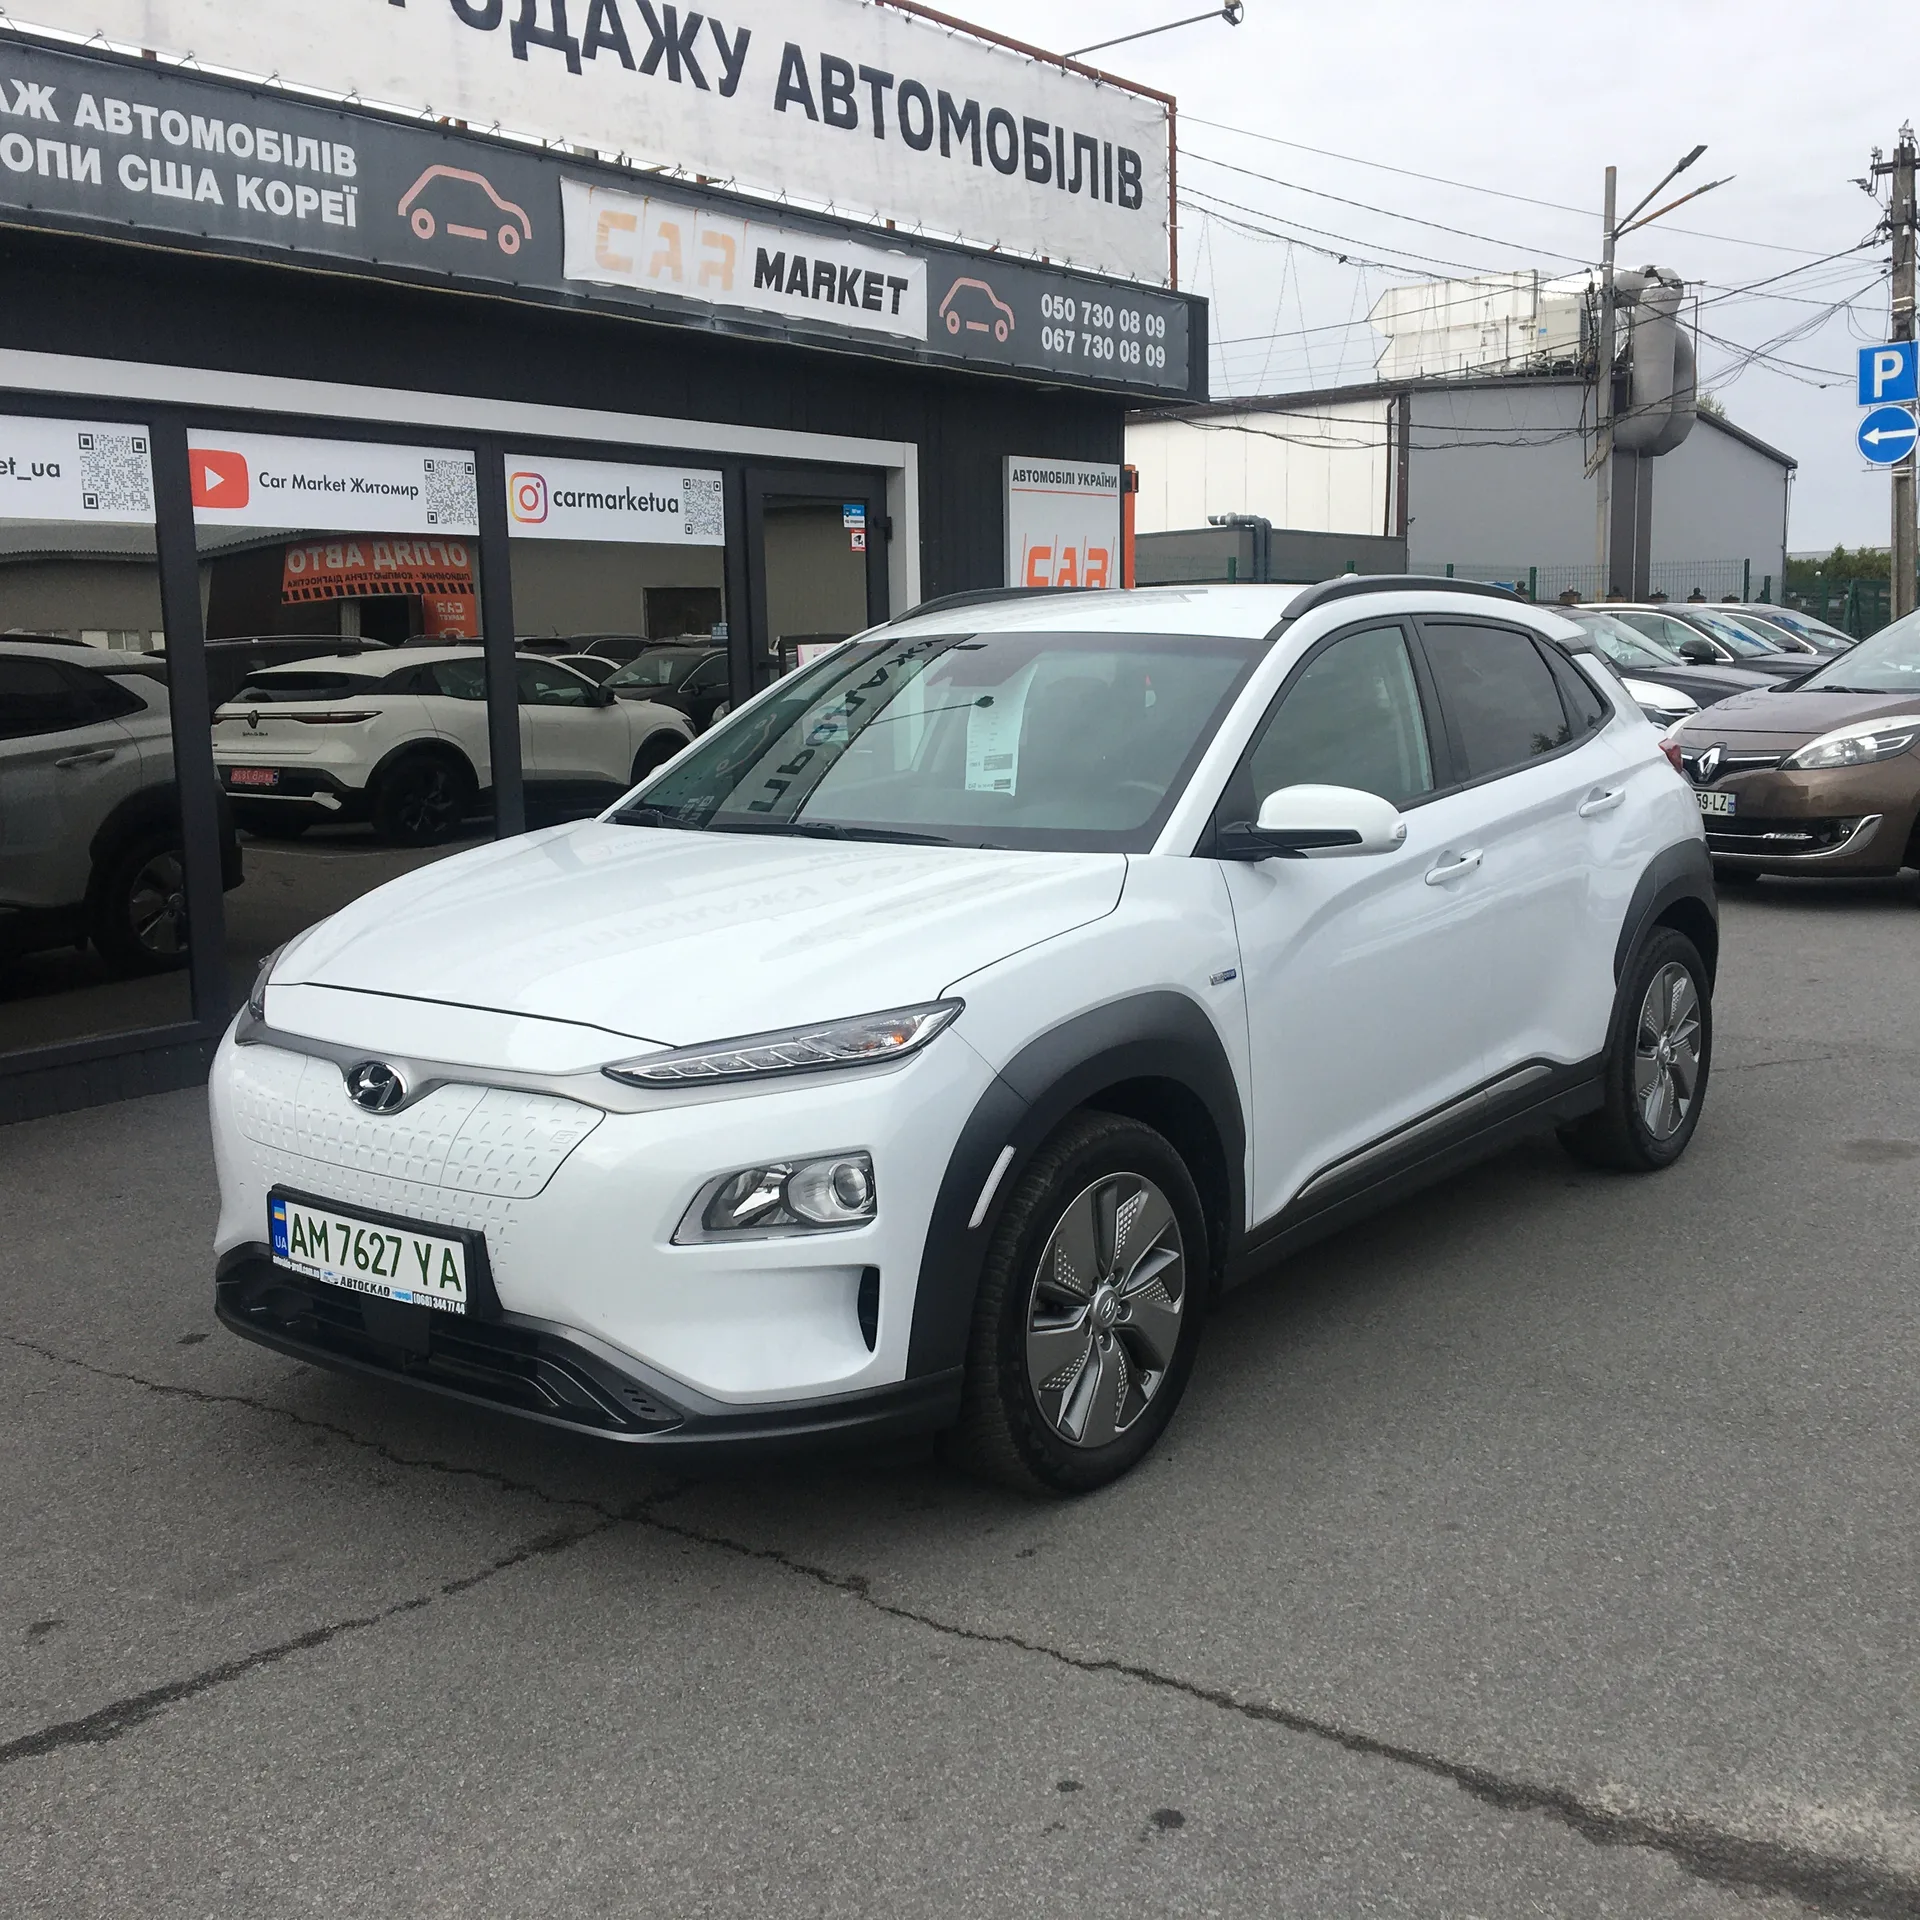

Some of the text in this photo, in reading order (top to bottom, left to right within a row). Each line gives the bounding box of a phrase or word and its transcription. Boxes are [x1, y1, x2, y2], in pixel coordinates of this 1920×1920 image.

[74, 93, 357, 177] АВТОМОБІЛІВ
[774, 41, 1143, 210] АВТОМОБІЛІВ
[0, 132, 358, 227] ОПИ США КОРЕЇ
[595, 209, 909, 315] CAR MARKET
[1041, 293, 1165, 338] 050 730 08 09
[1041, 326, 1165, 368] 067 730 08 09
[1874, 350, 1904, 398] P
[0, 456, 61, 481] et_ua
[259, 472, 419, 500] Car Market Житомир
[1012, 469, 1117, 488] АВТОМОБІЛІ УКРАЇНИ
[553, 486, 679, 513] carmarketua
[1026, 546, 1109, 588] CAR
[275, 1235, 287, 1250] UA
[290, 1213, 462, 1292] AM 7627 YA
